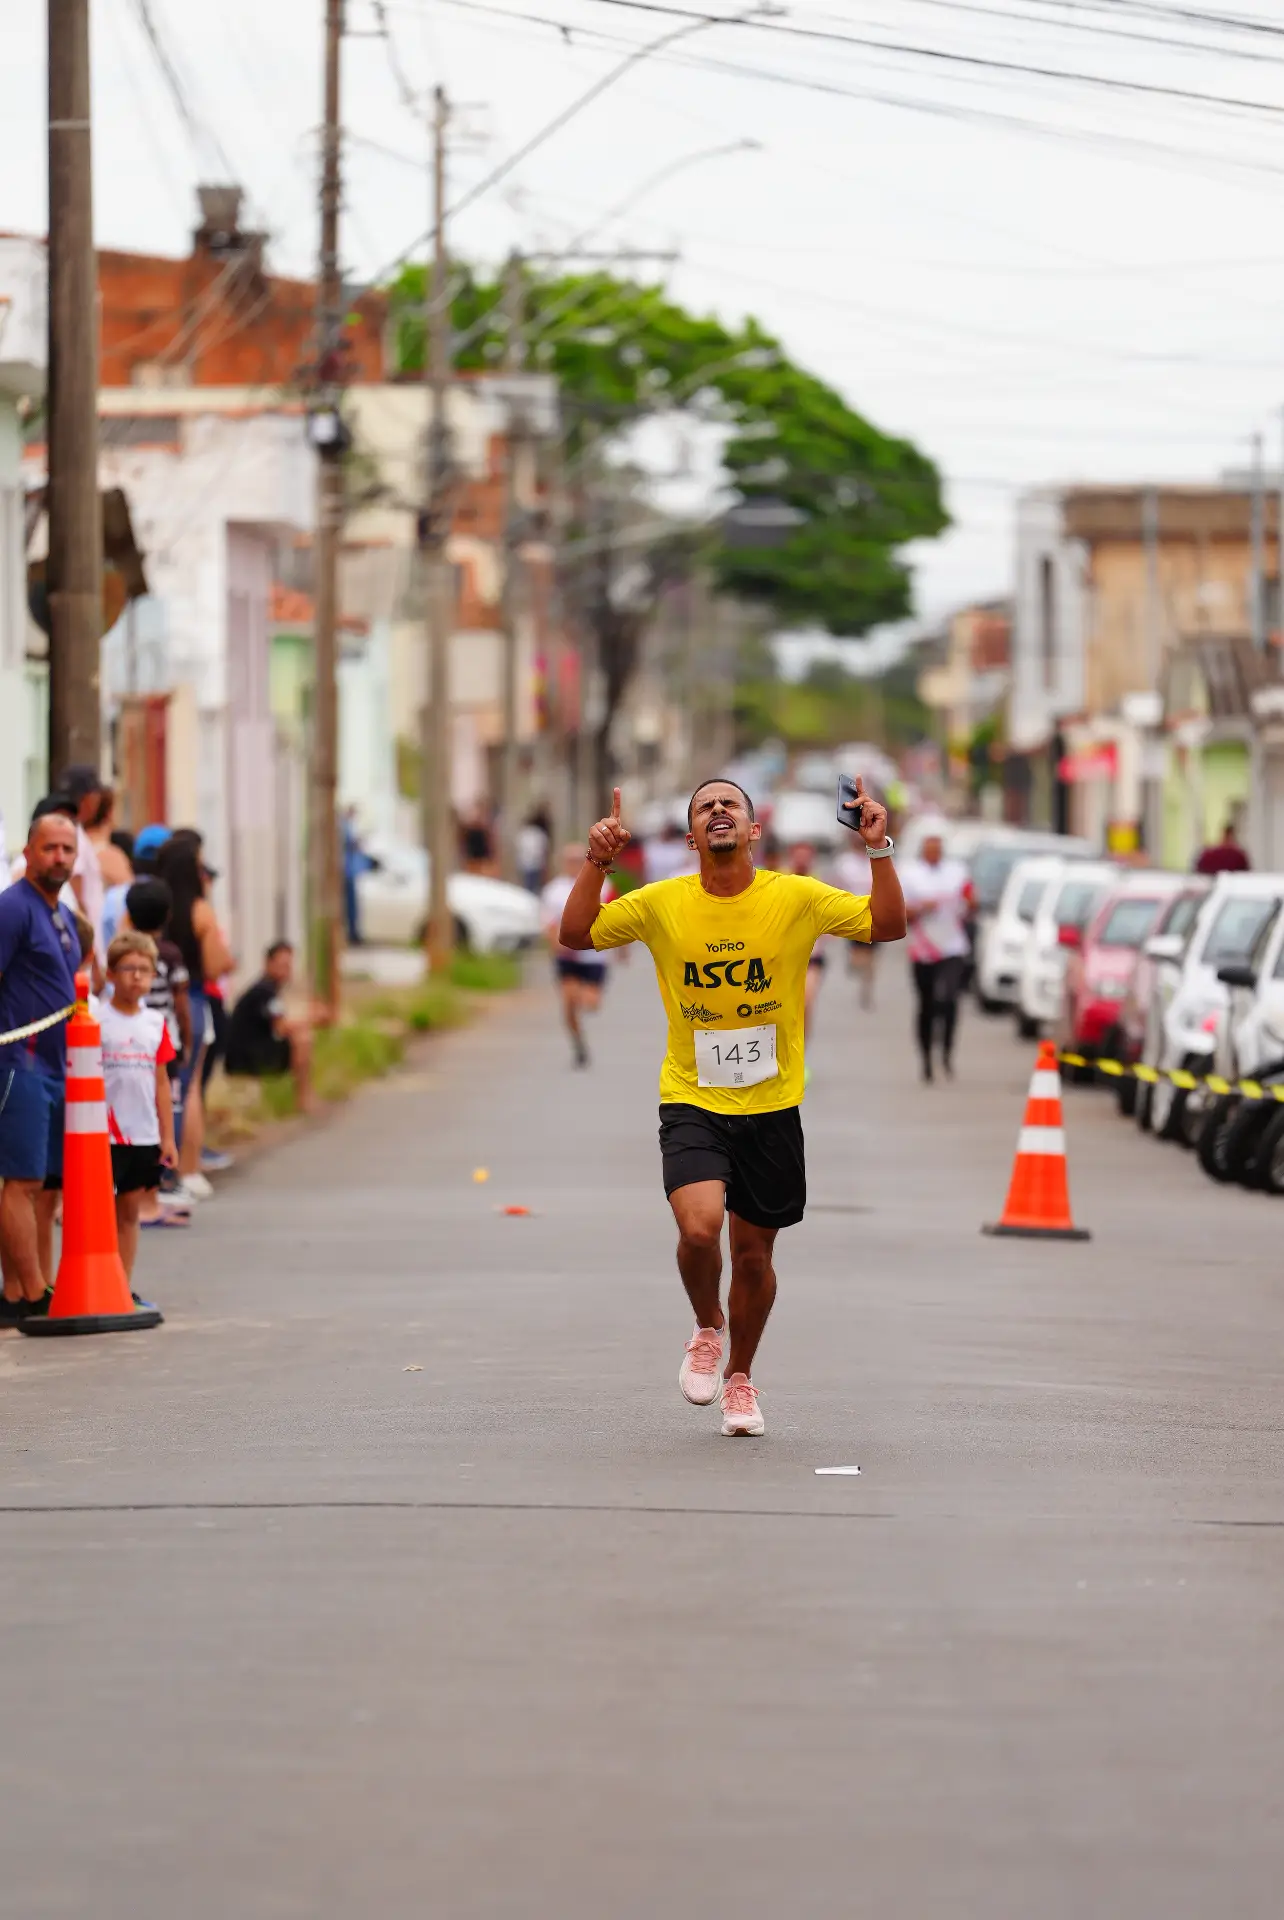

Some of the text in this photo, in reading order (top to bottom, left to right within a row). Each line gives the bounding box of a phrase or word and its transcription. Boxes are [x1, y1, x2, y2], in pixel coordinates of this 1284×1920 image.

[705, 941, 745, 953] YoPRO
[684, 958, 765, 988] ASCA
[744, 975, 772, 995] RUN
[711, 1040, 761, 1066] 143
